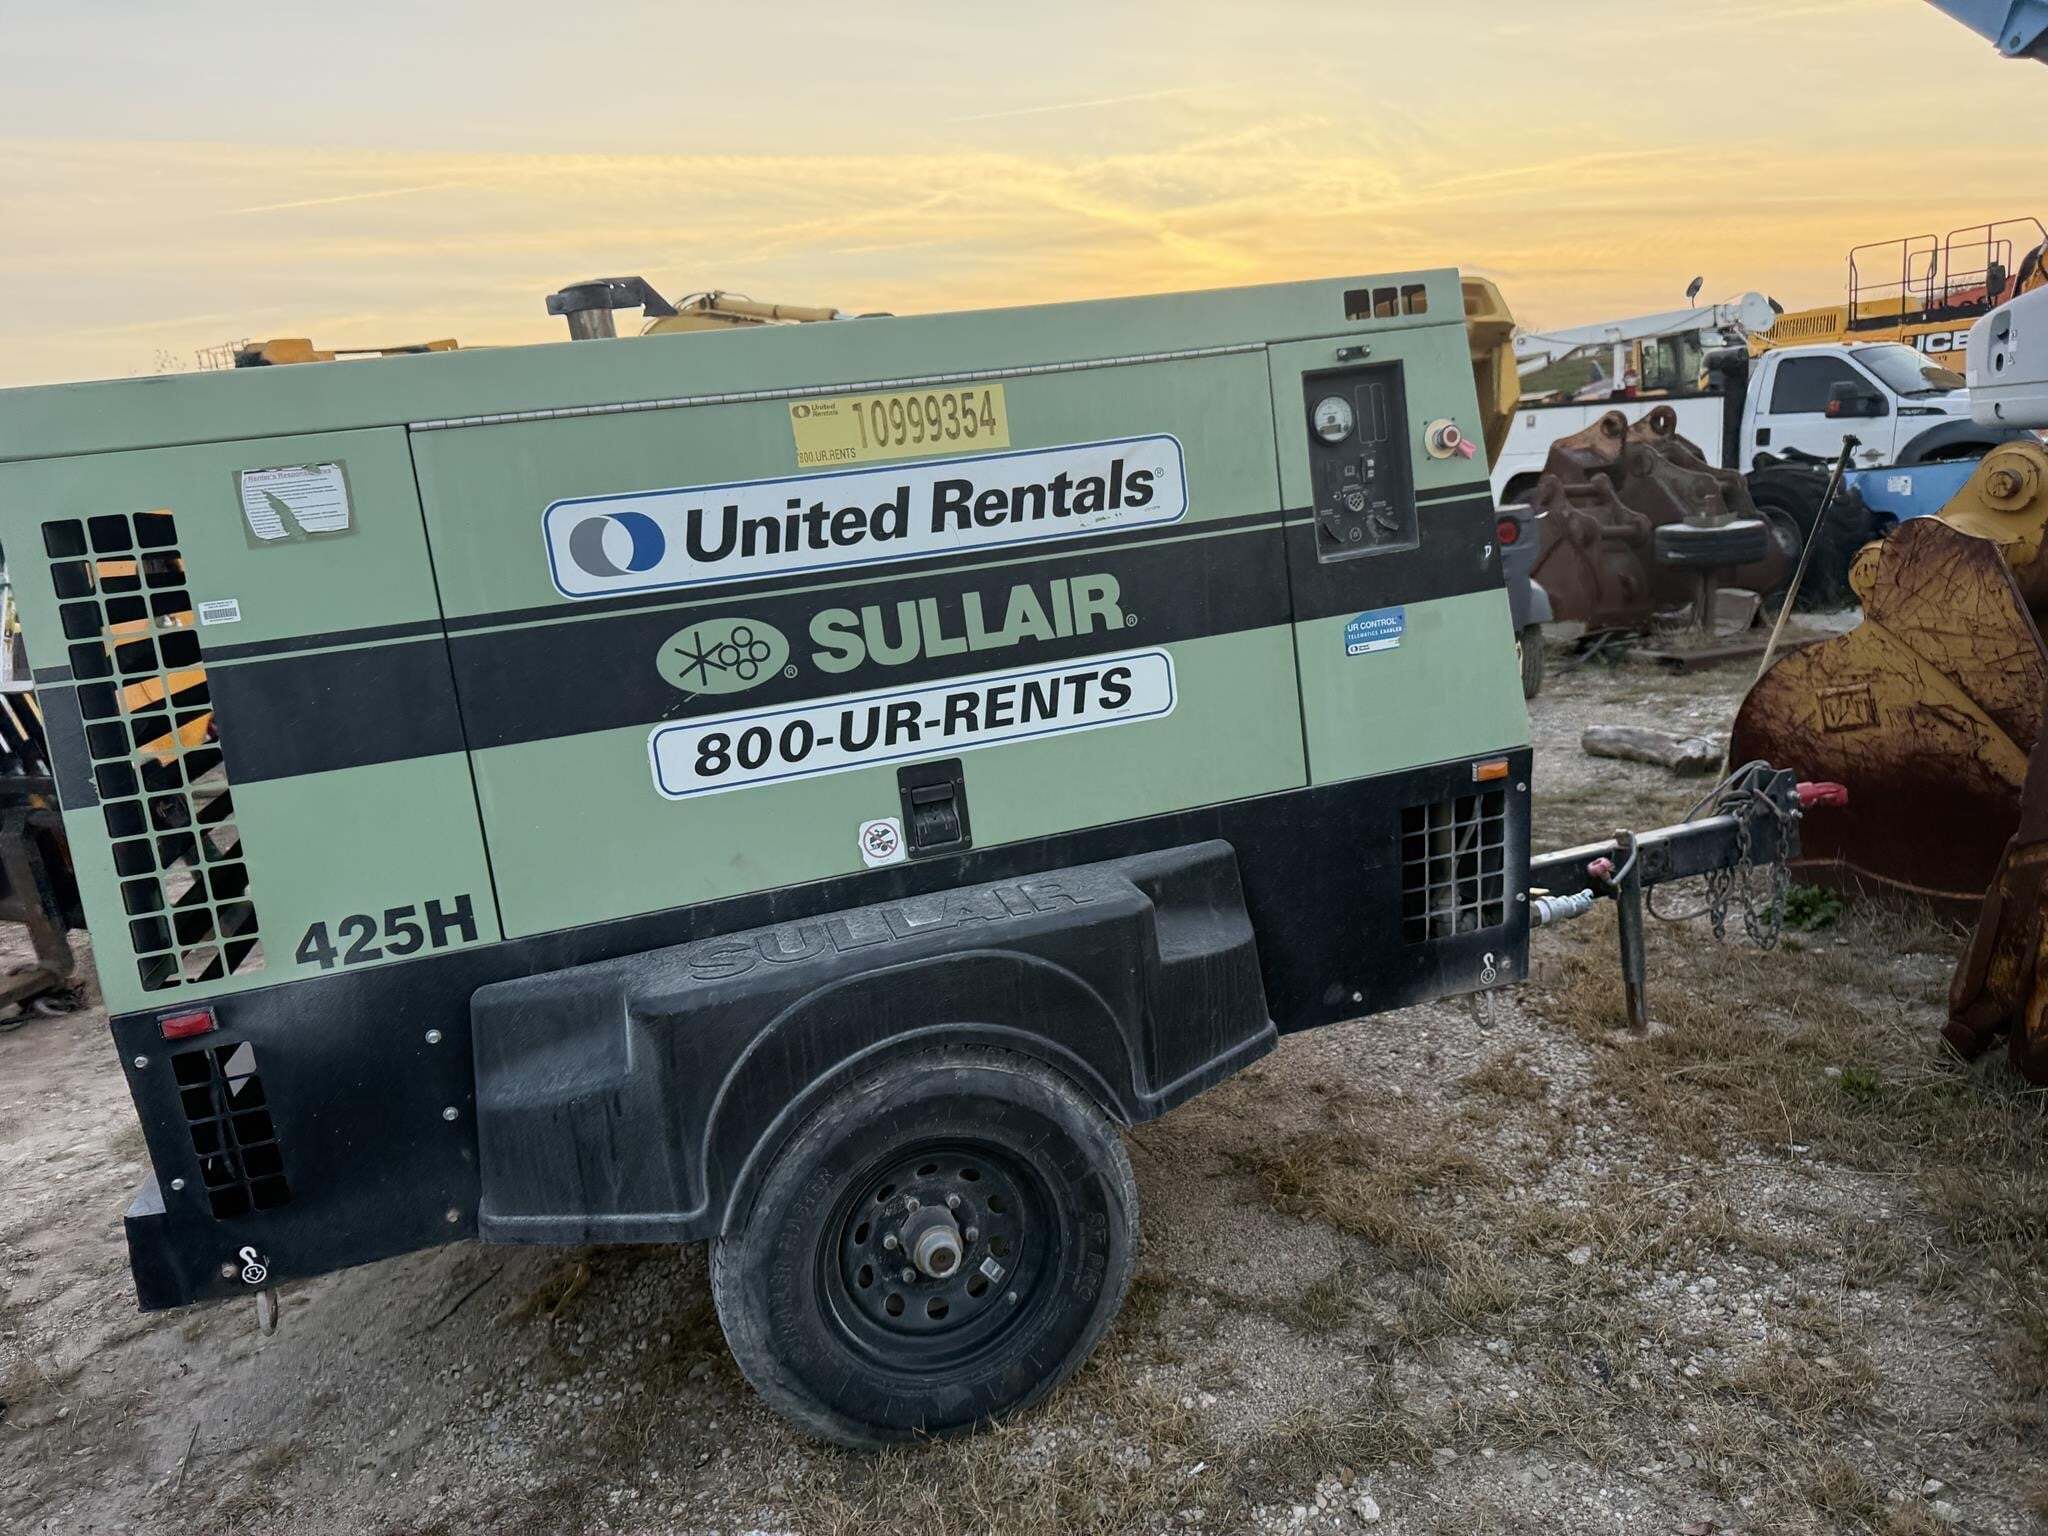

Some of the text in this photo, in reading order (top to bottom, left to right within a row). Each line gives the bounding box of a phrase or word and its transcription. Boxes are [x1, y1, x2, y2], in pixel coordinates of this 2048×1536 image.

[811, 403, 835, 411] United
[812, 410, 838, 418] Rentals
[852, 390, 996, 448] 10999354
[685, 459, 1154, 563] United Rentals
[809, 573, 1125, 673] SULLAIR
[1347, 617, 1397, 632] UR CONTROL
[694, 666, 1132, 777] 800-UR-RENTS
[295, 893, 478, 970] 425H
[688, 881, 1096, 981] SULLAIR
